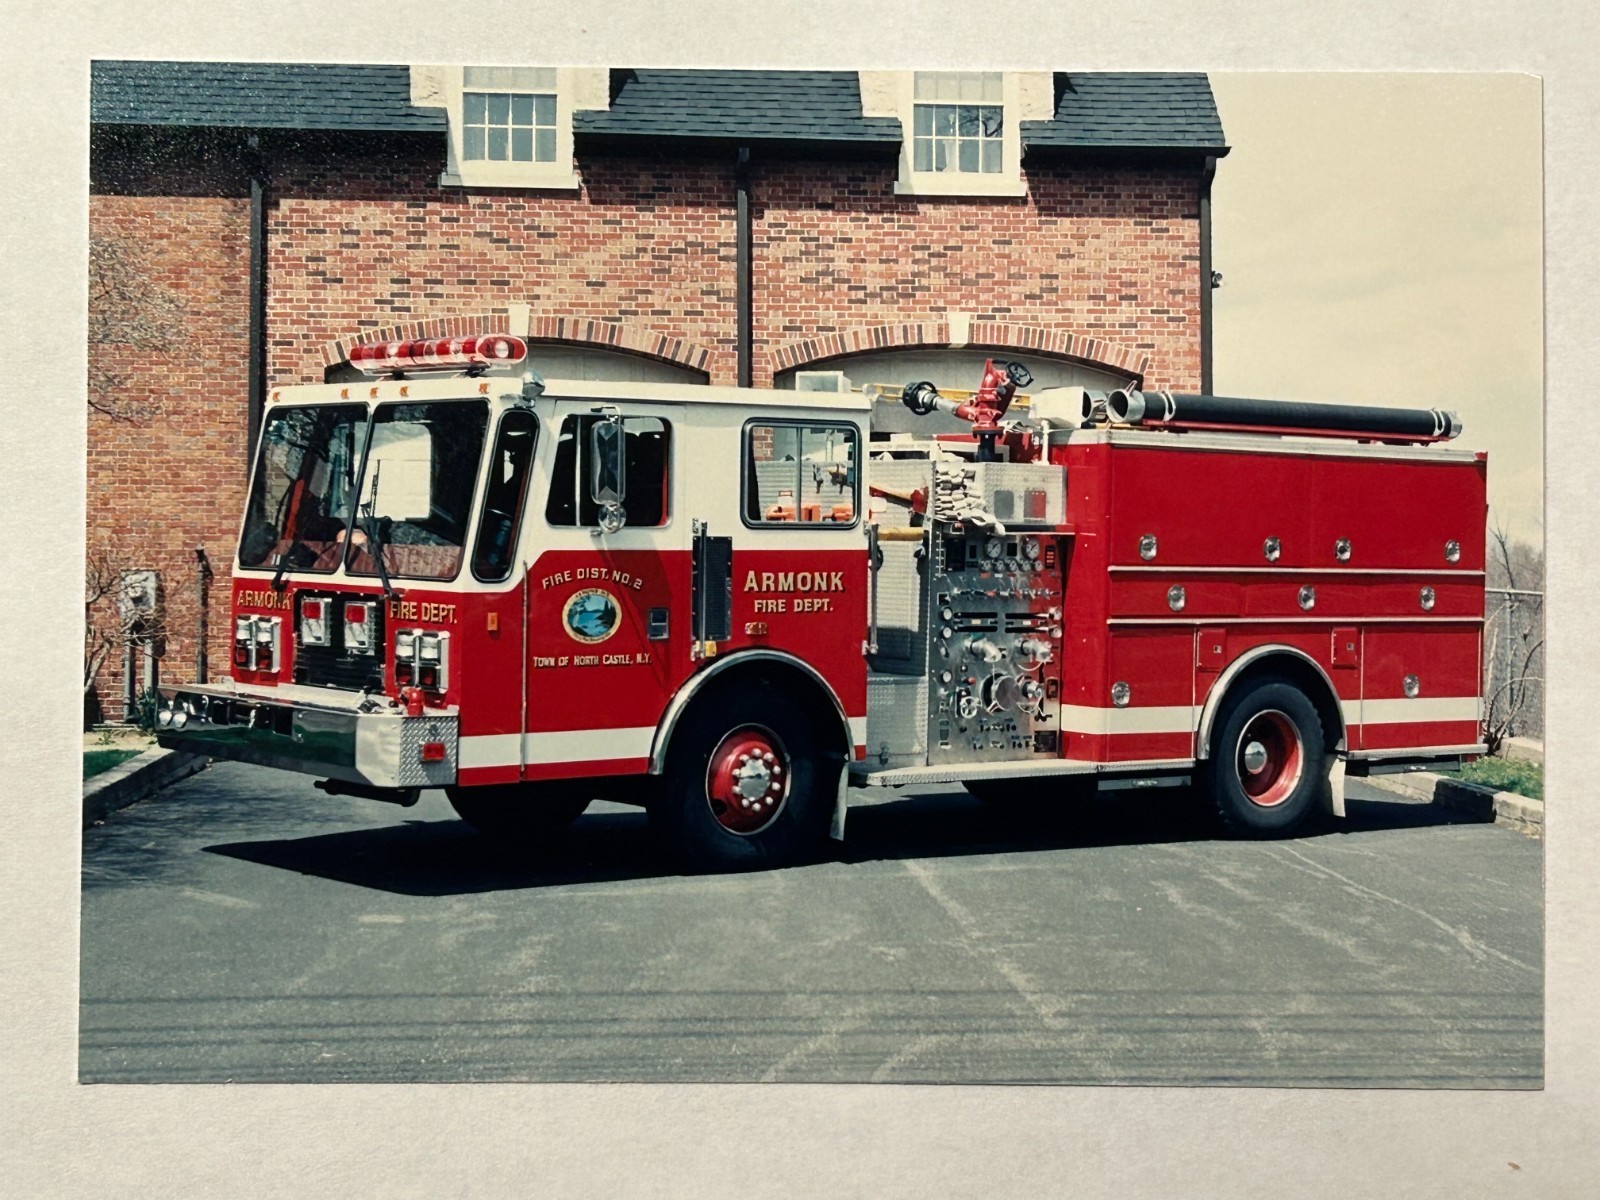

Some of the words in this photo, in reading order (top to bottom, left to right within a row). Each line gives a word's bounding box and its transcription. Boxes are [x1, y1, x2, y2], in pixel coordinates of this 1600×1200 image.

[542, 570, 573, 590] FIRE
[744, 570, 844, 592] ARMONK
[390, 600, 418, 620] FIRE
[421, 602, 458, 624] DEPT.
[754, 599, 786, 613] FIRE
[793, 598, 834, 612] DEPT.
[533, 655, 556, 668] TOWN
[558, 656, 569, 667] OF
[573, 655, 599, 666] NORTH
